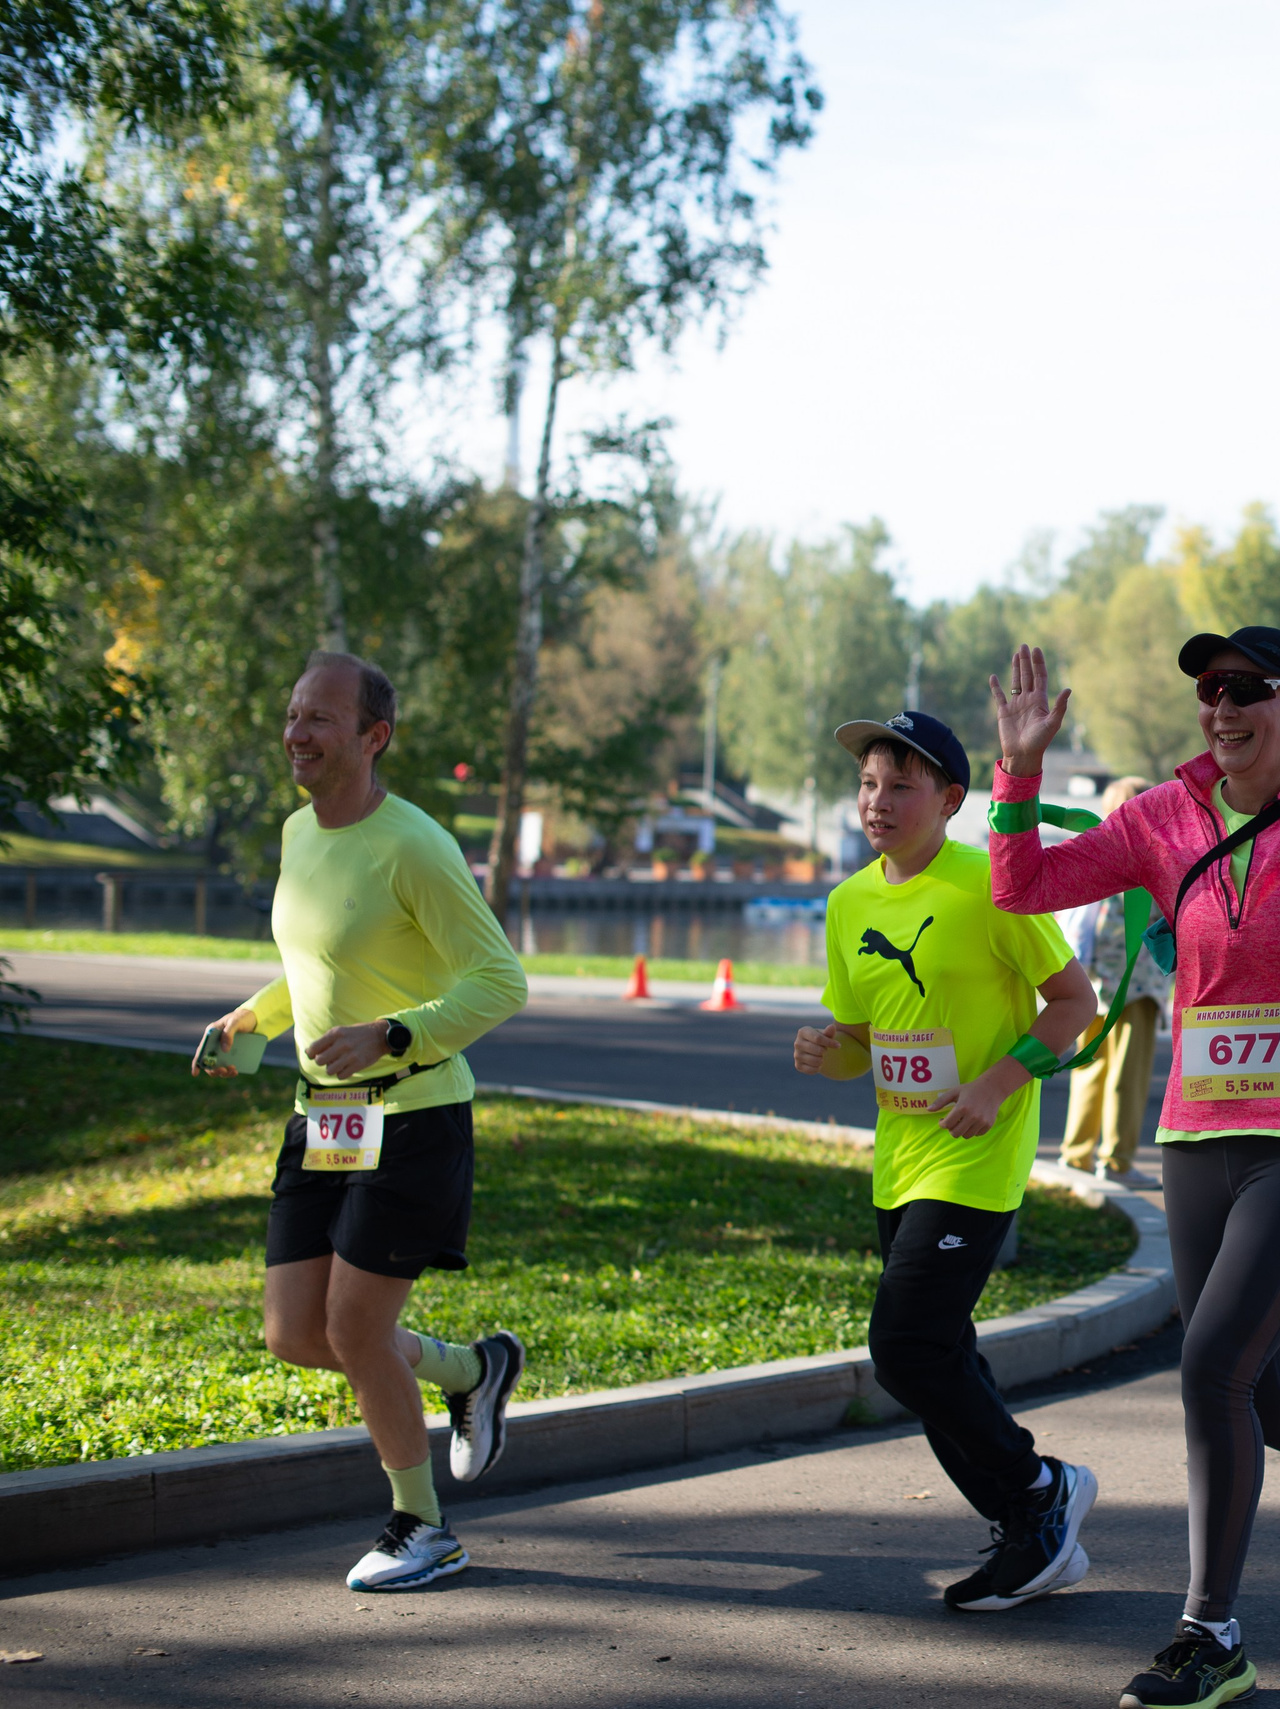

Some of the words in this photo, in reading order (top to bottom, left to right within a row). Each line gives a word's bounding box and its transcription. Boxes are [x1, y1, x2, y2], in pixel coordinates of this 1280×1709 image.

[1196, 1008, 1261, 1021] ИНКЛЮЗИВНЫЙ
[912, 1032, 934, 1042] ЗАБЕГ
[1209, 1032, 1280, 1066] 677
[881, 1054, 933, 1084] 678
[1225, 1080, 1250, 1095] 5,5
[893, 1096, 908, 1110] 5,5
[320, 1113, 364, 1140] 676
[944, 1233, 963, 1246] NIKE
